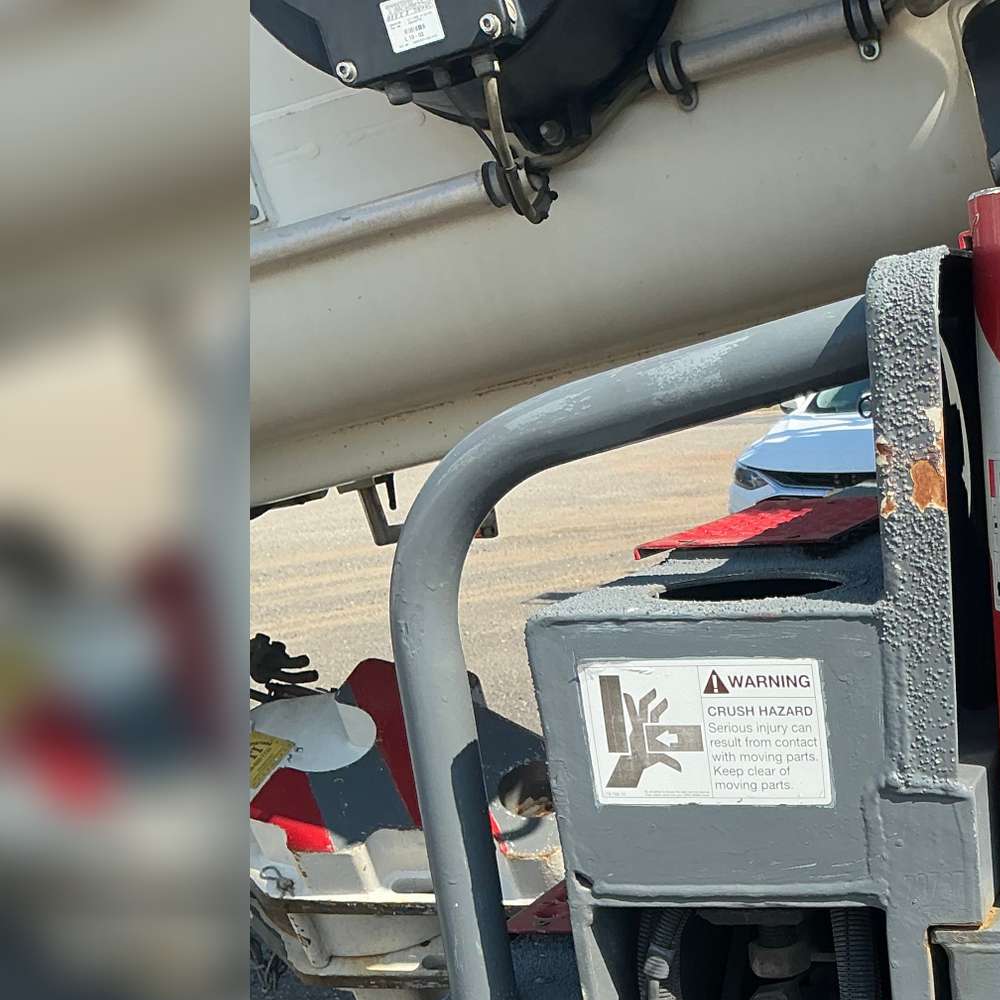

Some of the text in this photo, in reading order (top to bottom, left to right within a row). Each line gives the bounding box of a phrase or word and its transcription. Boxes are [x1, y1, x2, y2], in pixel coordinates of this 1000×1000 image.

[727, 674, 811, 688] WARNING
[707, 705, 813, 717] CRUSH HAZARD
[708, 722, 812, 735] Serious injury can
[710, 736, 818, 748] result from contact
[712, 751, 819, 765] with moving parts.
[713, 766, 790, 778] Keep clear of
[715, 780, 794, 792] moving parts.
